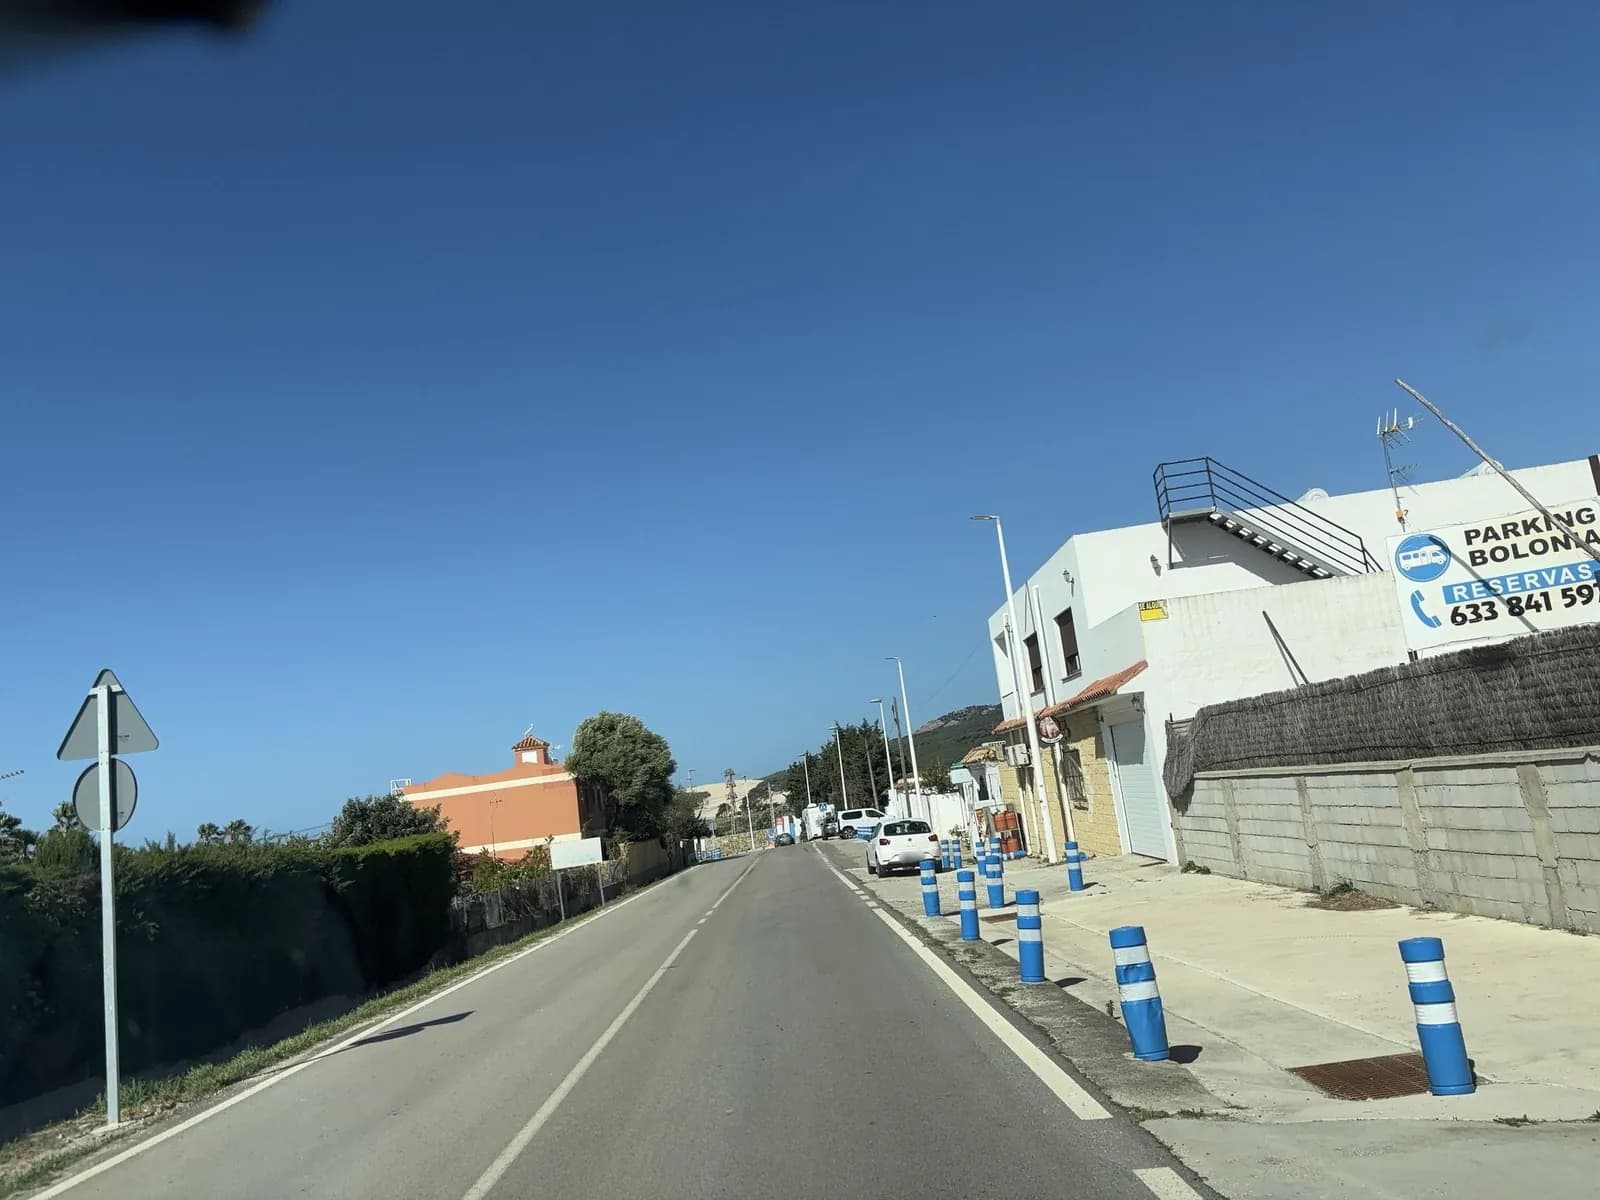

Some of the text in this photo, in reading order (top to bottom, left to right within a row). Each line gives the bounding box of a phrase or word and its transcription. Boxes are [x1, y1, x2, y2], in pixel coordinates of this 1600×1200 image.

[1464, 507, 1597, 546] PARKING
[1452, 564, 1592, 602] RESERVAS
[1450, 583, 1600, 626] 633 841 59
